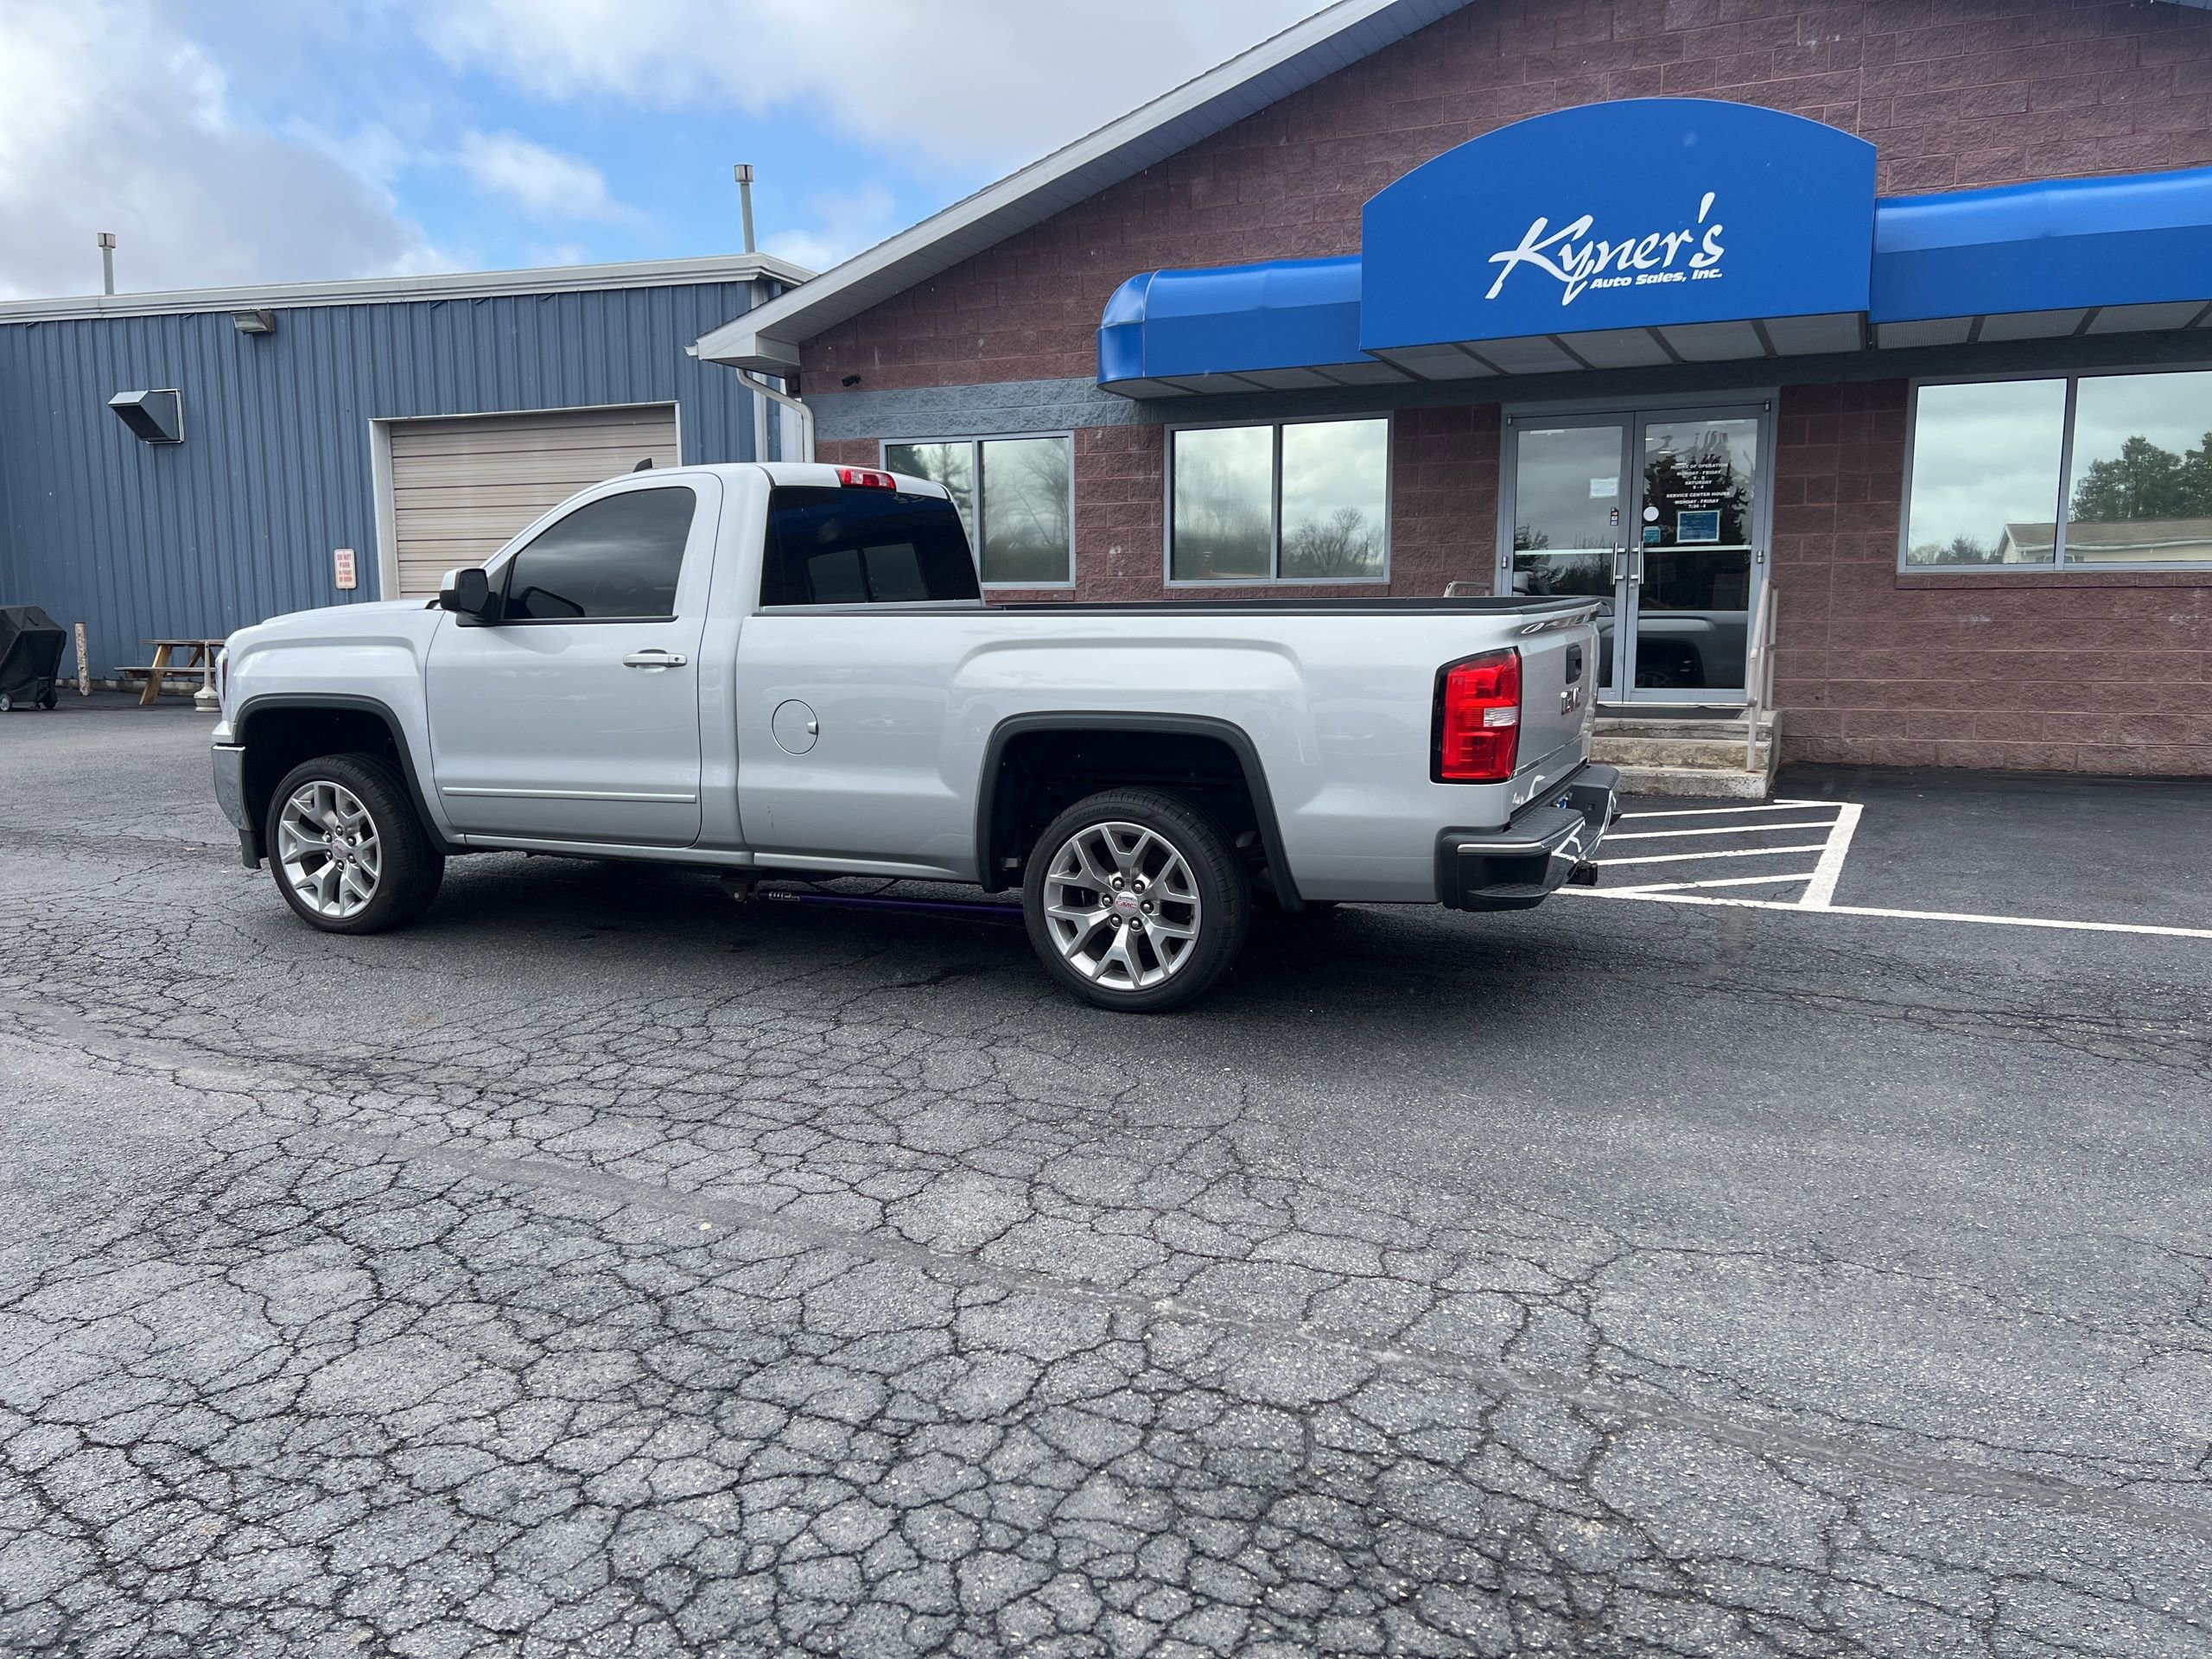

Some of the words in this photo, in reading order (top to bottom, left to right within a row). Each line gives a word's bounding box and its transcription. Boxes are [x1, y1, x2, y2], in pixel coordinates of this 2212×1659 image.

[1484, 192, 1726, 306] Kyner's
[1589, 276, 1632, 289] Auto
[1635, 270, 1688, 284] Sales,
[1692, 268, 1723, 280] Inc.
[1116, 900, 1137, 909] GMC
